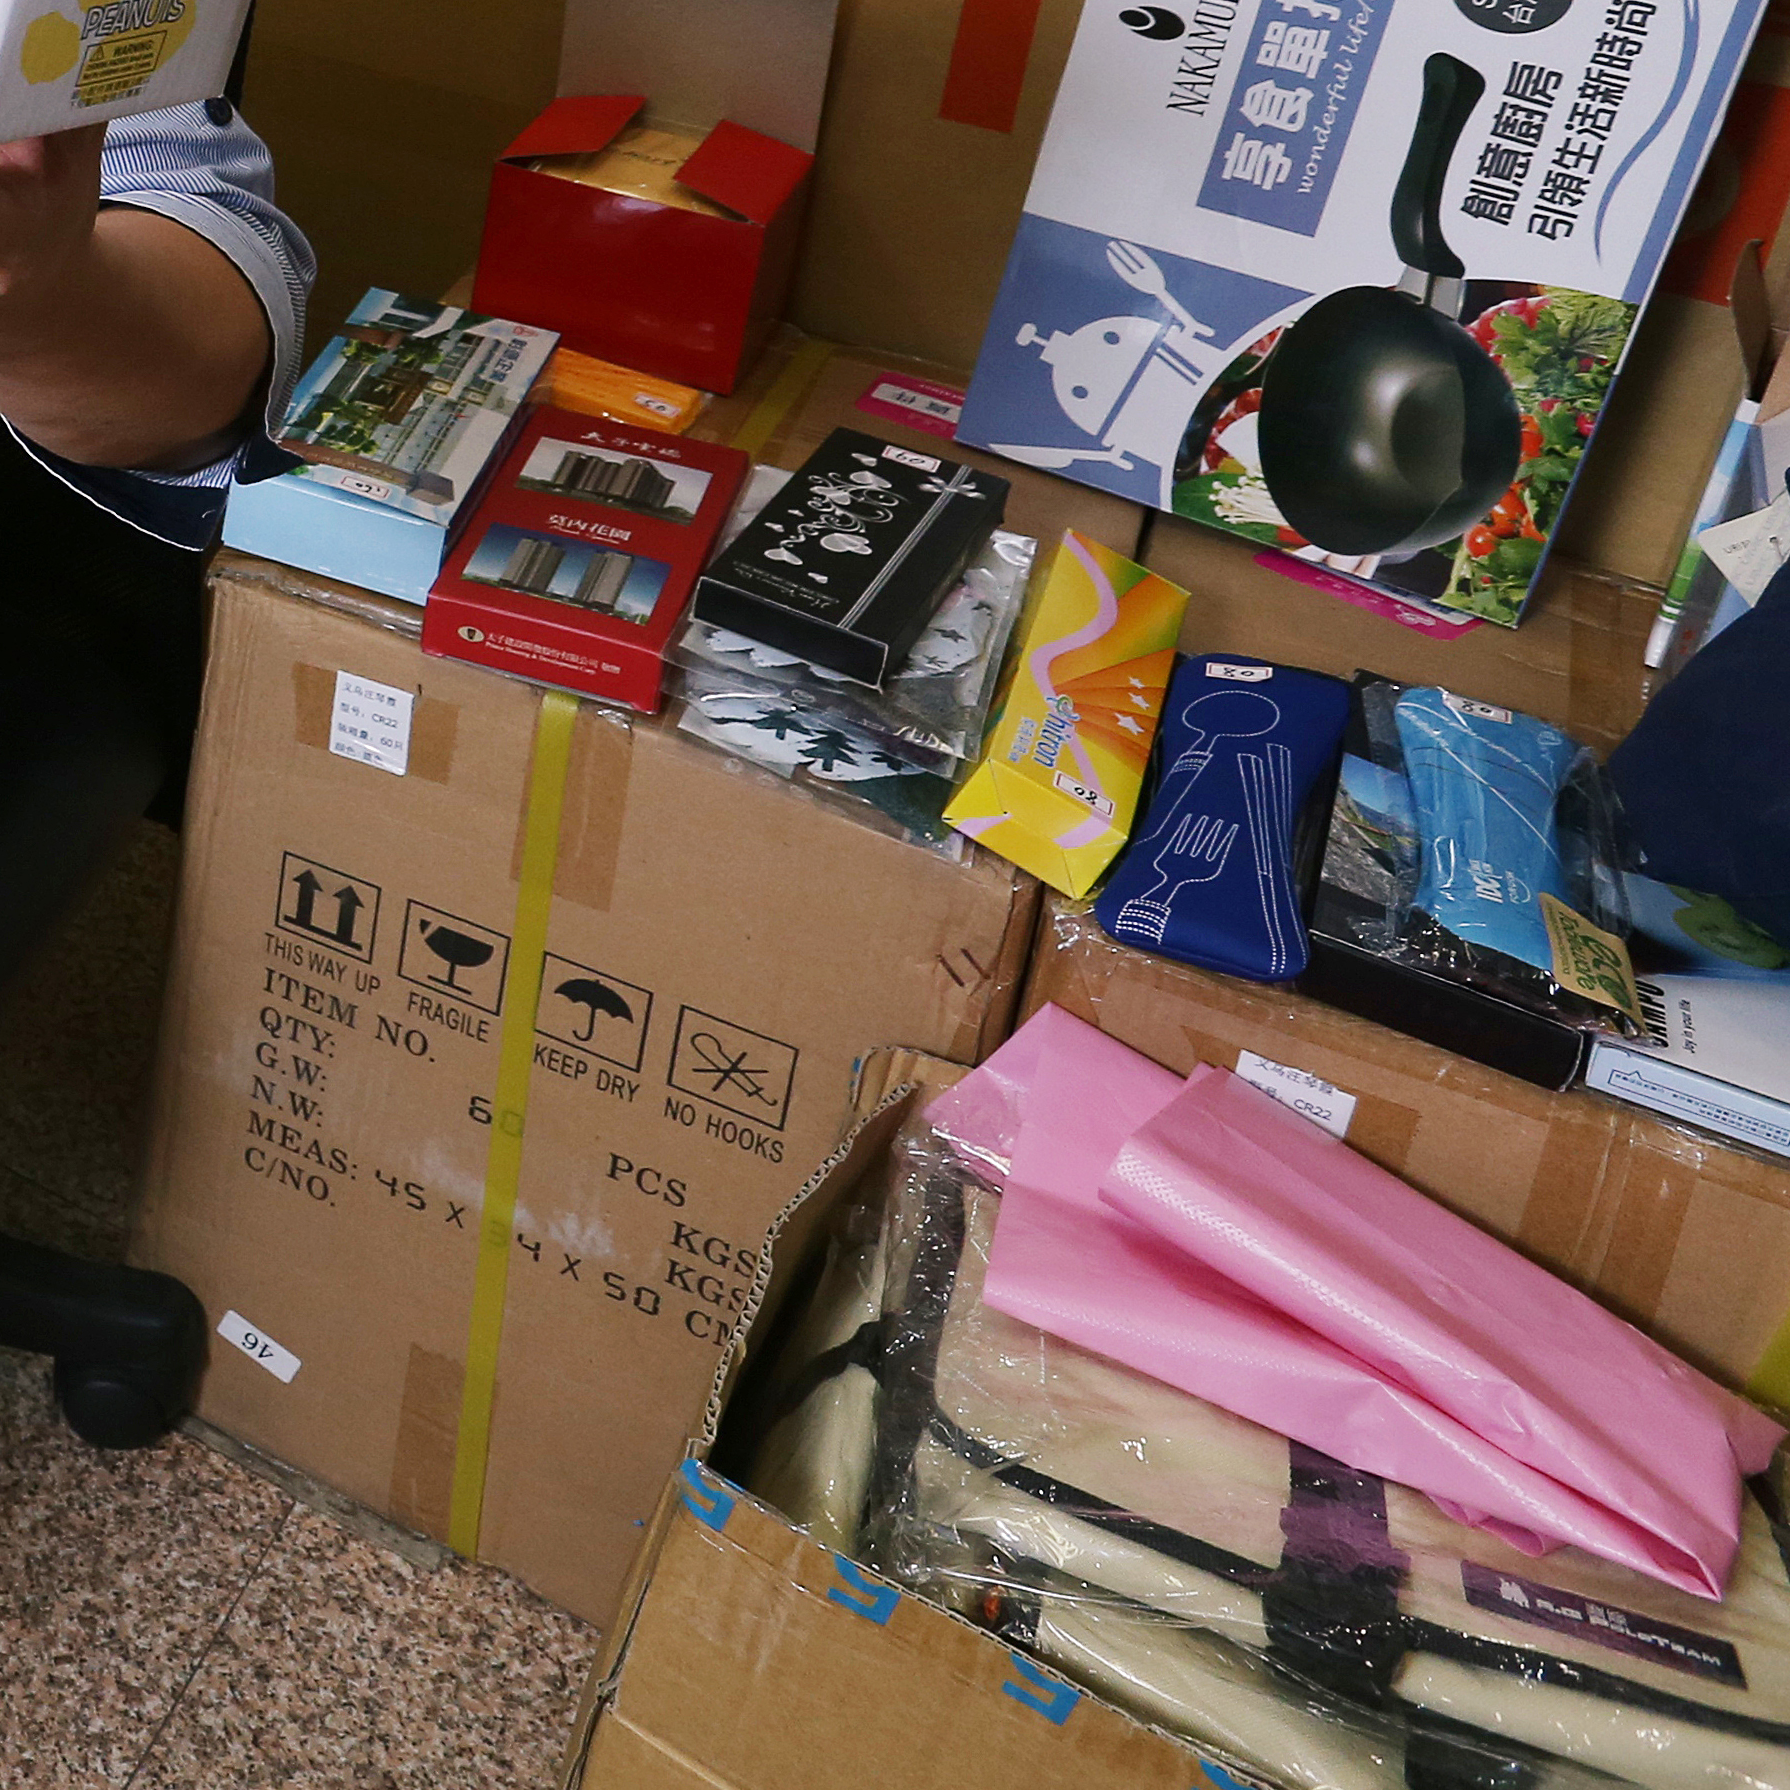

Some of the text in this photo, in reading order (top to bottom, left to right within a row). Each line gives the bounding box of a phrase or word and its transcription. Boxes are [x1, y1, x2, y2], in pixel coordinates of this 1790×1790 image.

[1297, 55, 1357, 196] wonderful
[1458, 60, 1565, 227] 創意廚房
[371, 713, 399, 729] CR22
[263, 933, 381, 998] THIS WAY UP
[262, 968, 436, 1063] ITEM NO.
[407, 991, 490, 1044] FRAGILE
[251, 1075, 325, 1127] N.W:
[258, 1006, 337, 1060] QTY:
[606, 1152, 689, 1210] PCS
[533, 1046, 640, 1105] KEEP DRY
[663, 1096, 785, 1166] NO HOOKS
[1293, 1099, 1332, 1121] CR22
[244, 1146, 337, 1209] C/NO.
[254, 1042, 759, 1278] G.W: KGS
[246, 1112, 662, 1317] MEAS: 45 50
